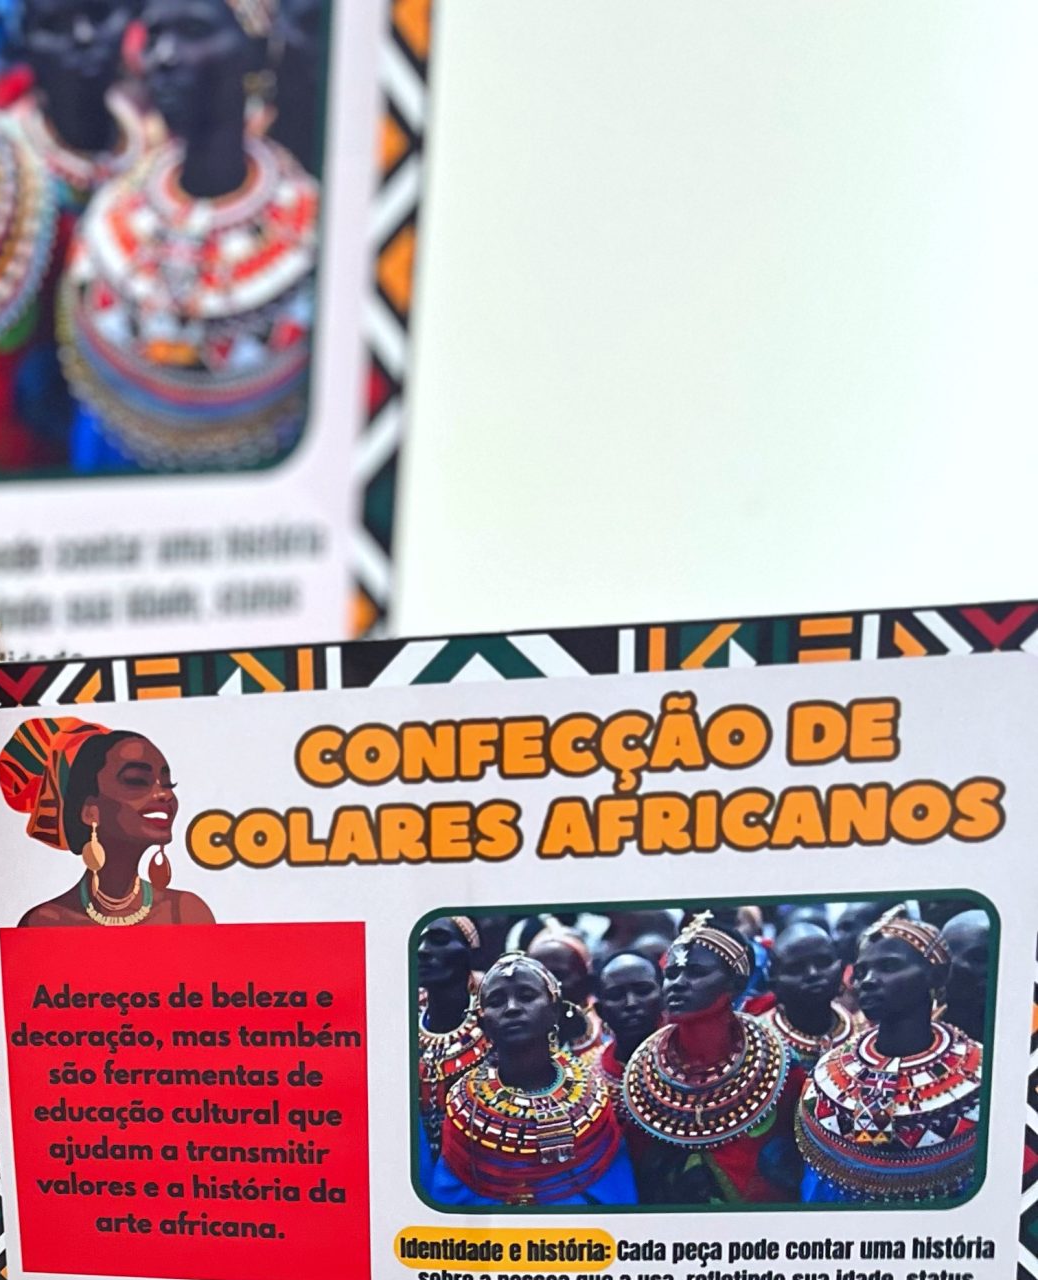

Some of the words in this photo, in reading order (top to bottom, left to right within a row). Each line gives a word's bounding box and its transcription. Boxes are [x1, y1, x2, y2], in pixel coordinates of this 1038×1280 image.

[294, 690, 771, 791] CONFECÇÃO
[786, 698, 901, 766] DE
[186, 799, 523, 870] COLARES
[536, 776, 1007, 864] AFRICANOS
[32, 983, 160, 1015] Adereços
[167, 982, 203, 1009] de
[212, 982, 307, 1008] beleza
[316, 989, 333, 1008] e
[11, 1022, 164, 1053] decoração,
[172, 1027, 231, 1047] mas
[239, 1021, 362, 1048] também
[49, 1062, 96, 1085] são
[104, 1060, 279, 1086] ferramentas
[287, 1062, 323, 1087] de
[34, 1097, 164, 1129] educação
[172, 1099, 279, 1125] cultural
[288, 1108, 342, 1132] que
[49, 1136, 153, 1165] ajudam
[160, 1143, 178, 1161] a
[186, 1140, 330, 1164] transmitir
[36, 1172, 136, 1196] valores
[144, 1178, 159, 1197] e
[167, 1179, 184, 1198] a
[192, 1175, 300, 1202] história
[308, 1179, 346, 1203] da
[96, 1212, 152, 1233] arte
[159, 1211, 285, 1239] africana.
[400, 1237, 504, 1261] Identidade
[509, 1242, 521, 1262] e
[527, 1238, 611, 1262] história:
[616, 1240, 666, 1262] Cada
[672, 1240, 722, 1267] peça
[728, 1239, 780, 1263] pode
[785, 1238, 855, 1260] contar
[860, 1240, 906, 1260] uma
[911, 1235, 995, 1259] história
